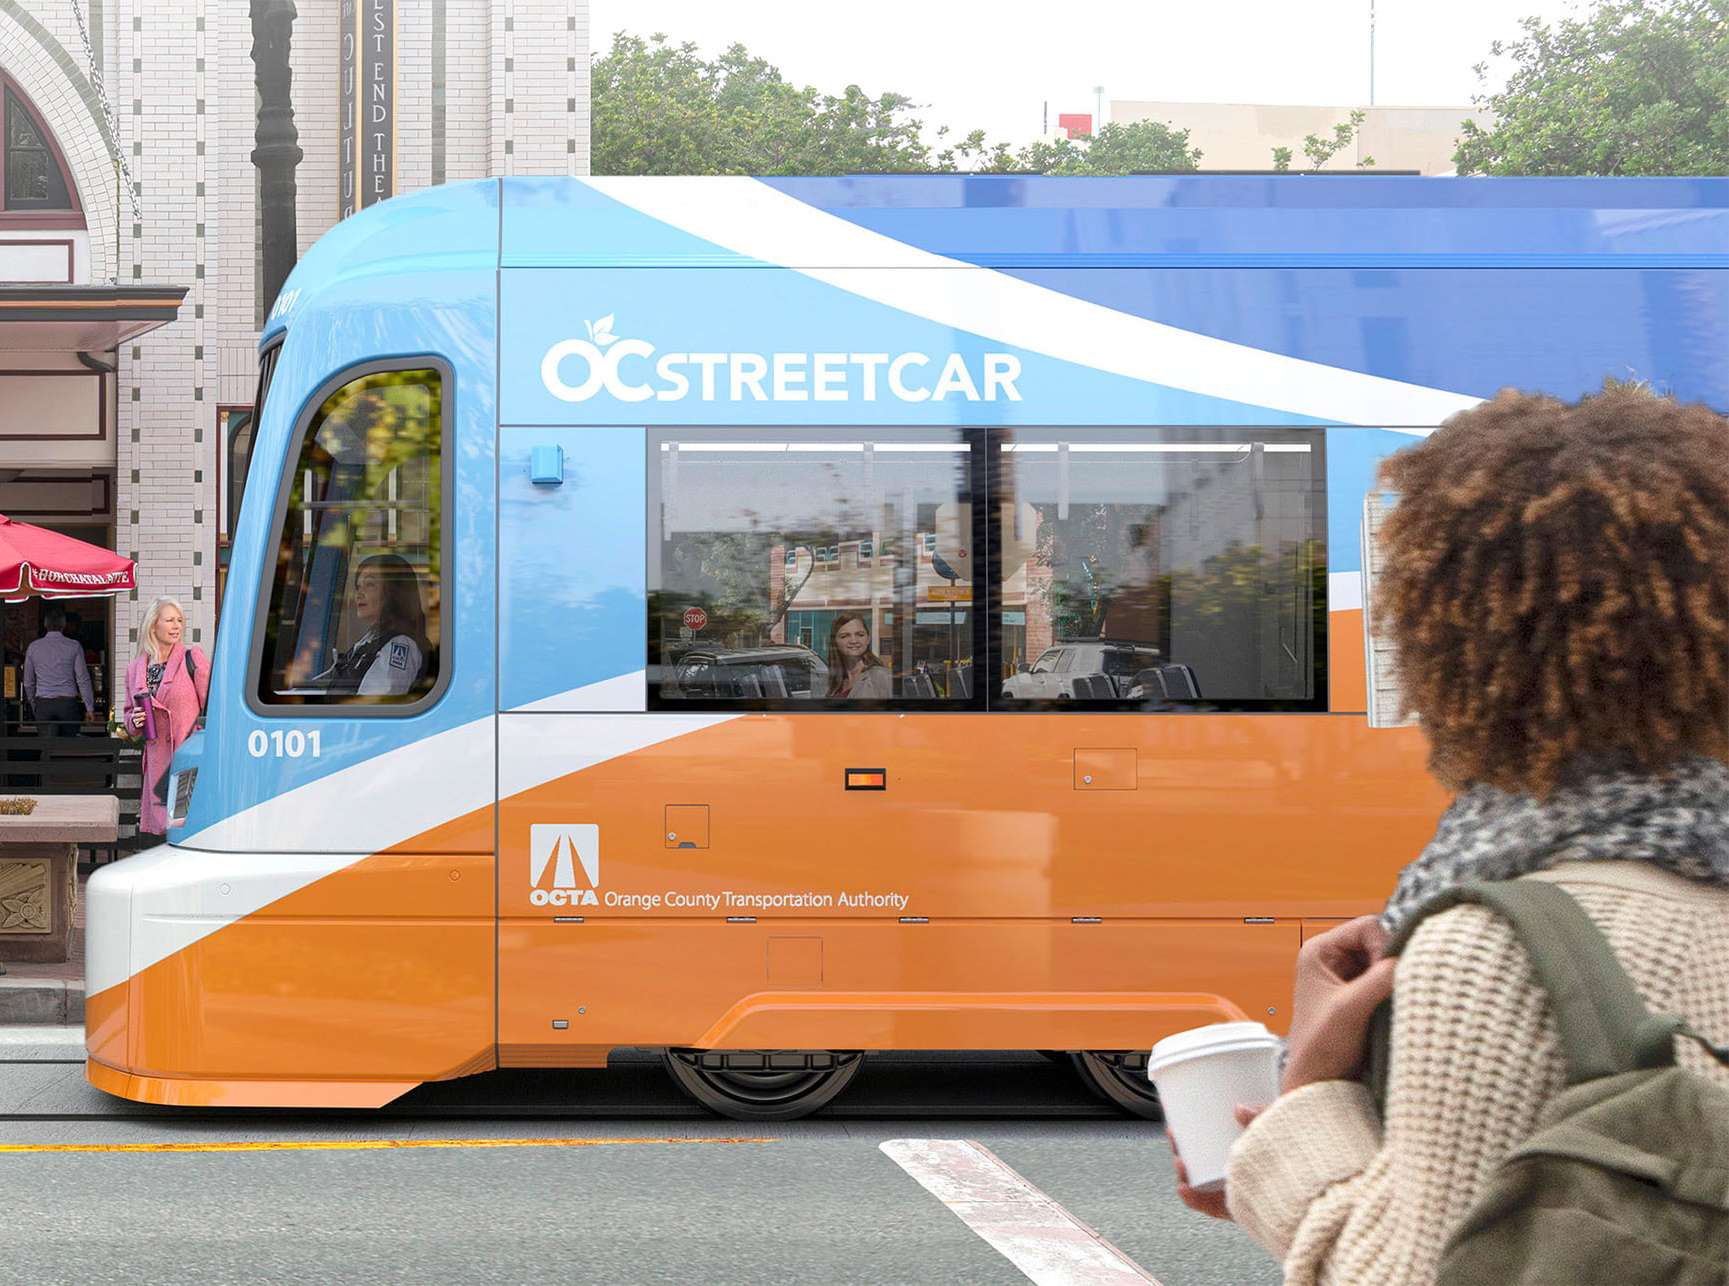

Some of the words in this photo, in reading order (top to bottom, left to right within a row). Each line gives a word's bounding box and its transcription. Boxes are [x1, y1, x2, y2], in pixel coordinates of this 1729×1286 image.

[372, 63, 386, 123] END
[685, 613, 705, 624] STOP
[247, 729, 321, 758] 0101
[529, 889, 600, 906] OCTA
[604, 891, 661, 911] Orange
[664, 891, 721, 911] County
[721, 891, 833, 911] Transportation
[837, 891, 910, 911] Authority
